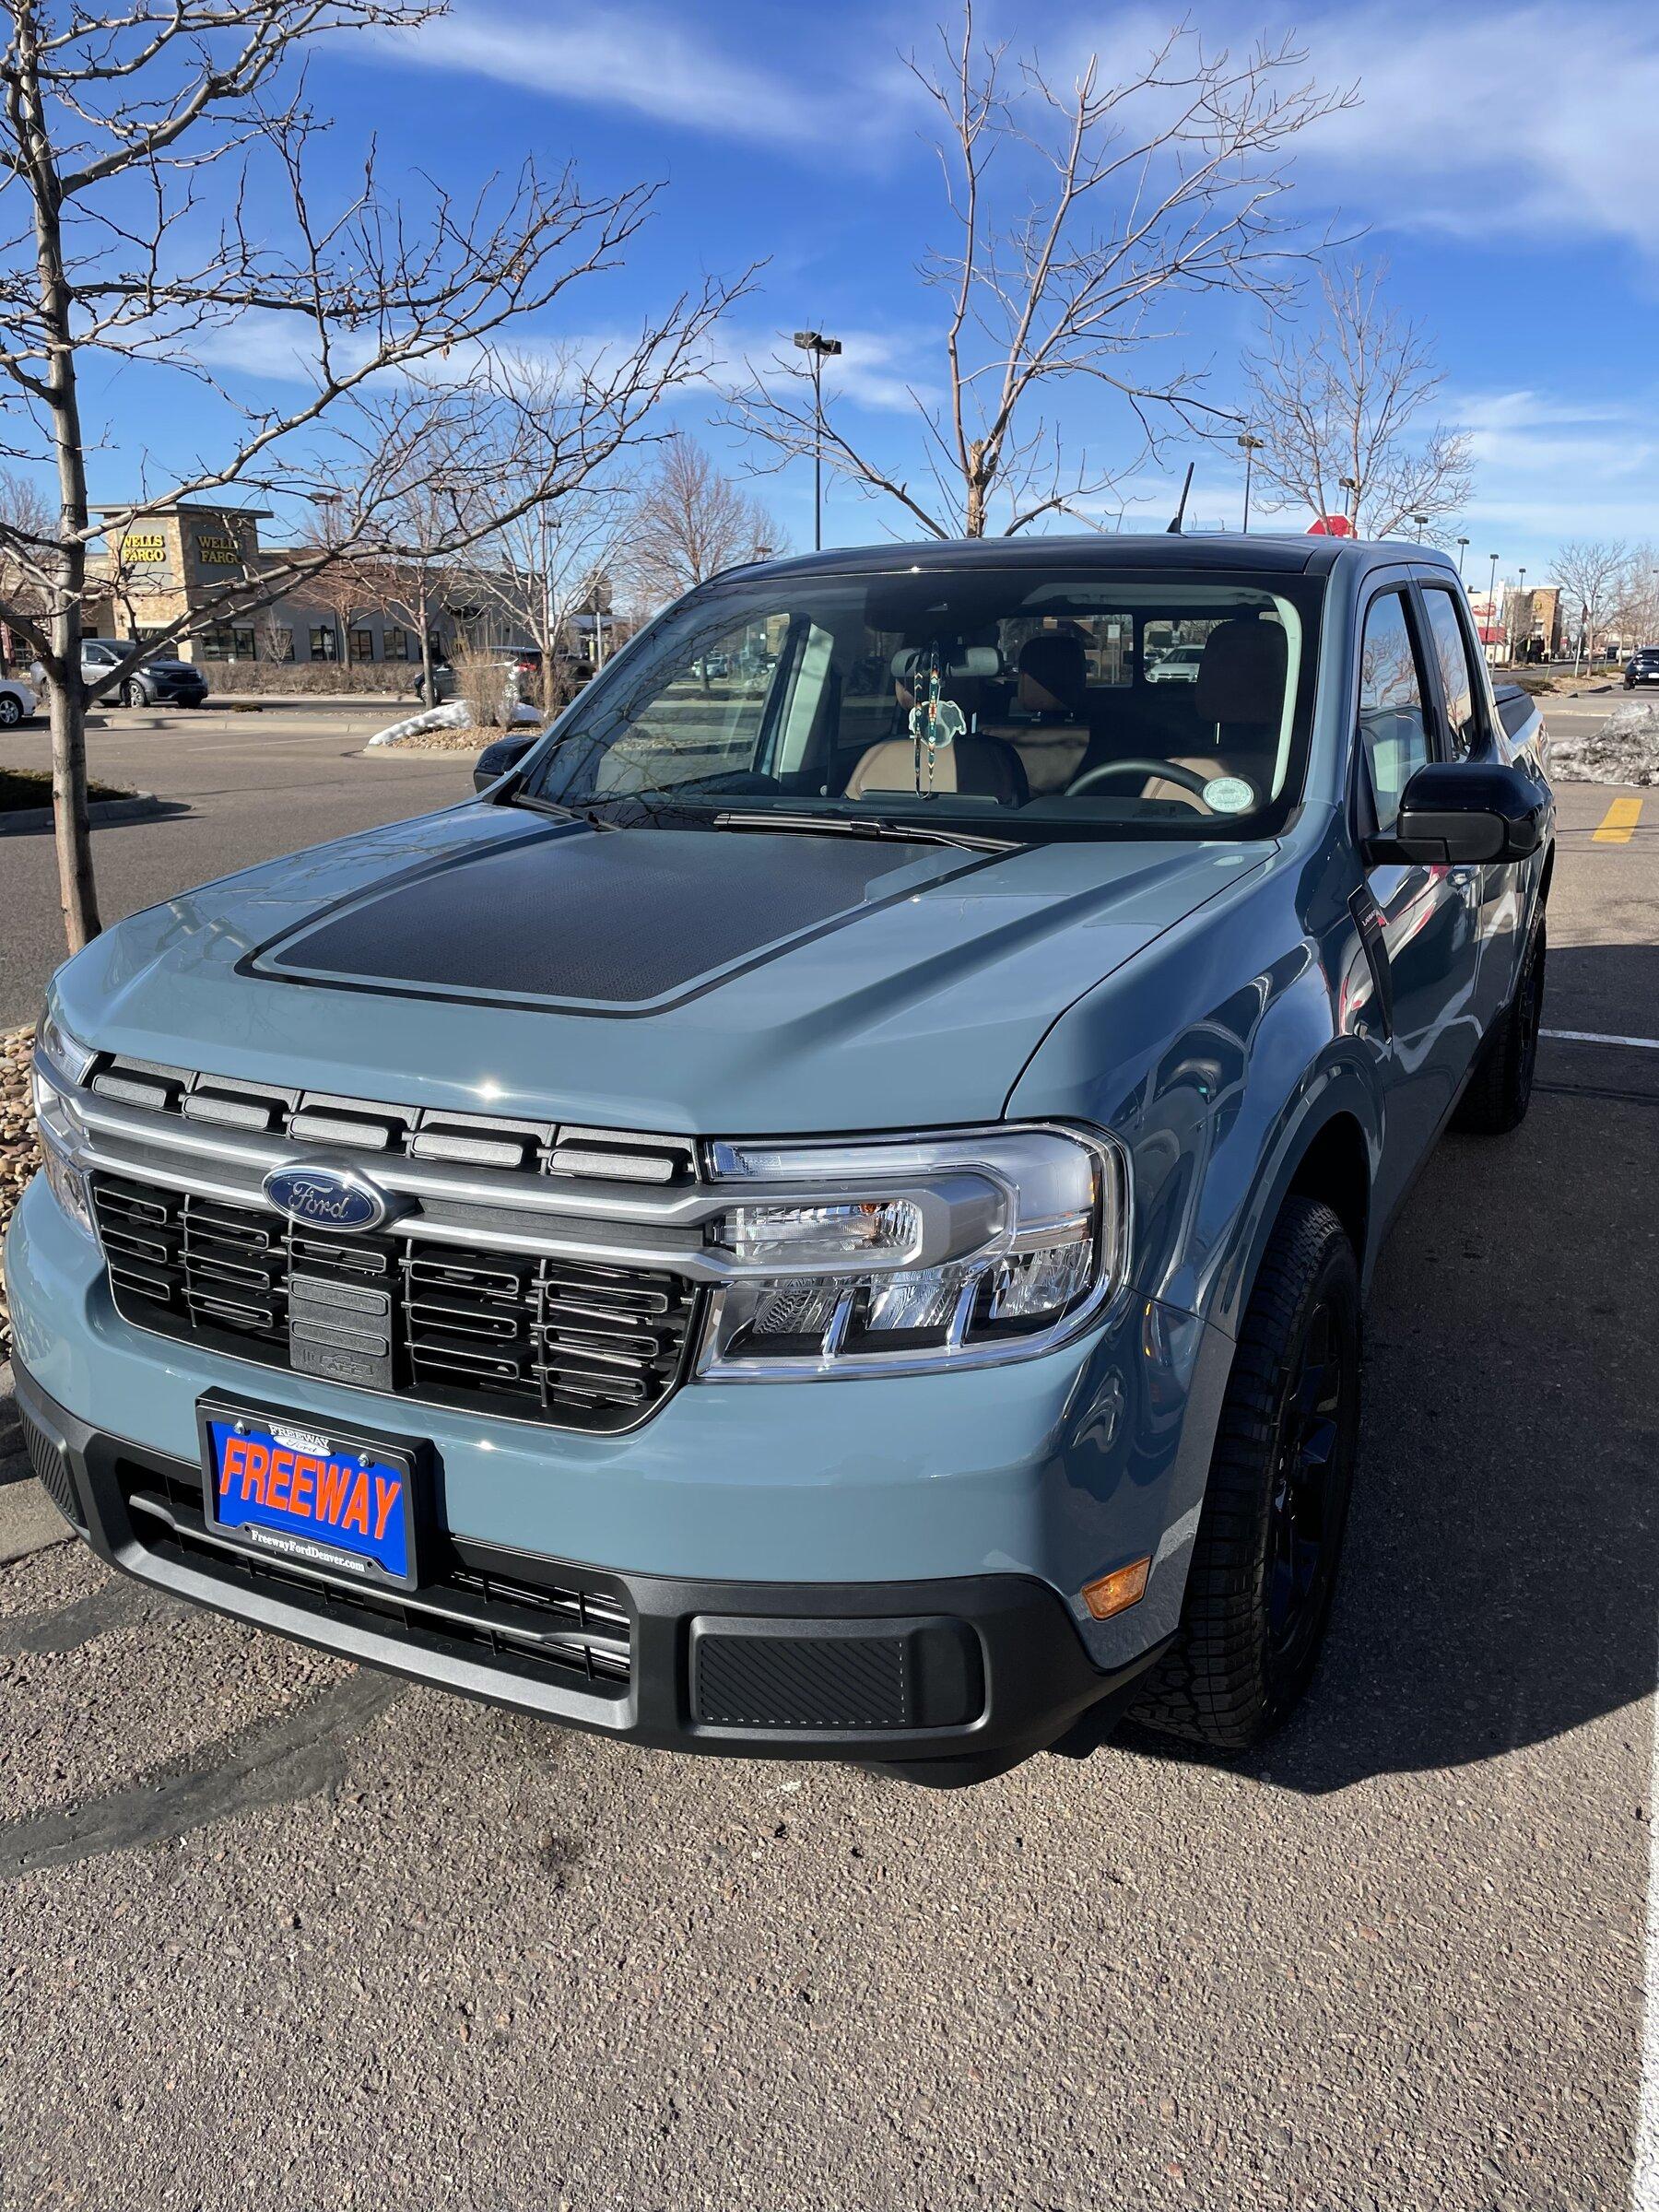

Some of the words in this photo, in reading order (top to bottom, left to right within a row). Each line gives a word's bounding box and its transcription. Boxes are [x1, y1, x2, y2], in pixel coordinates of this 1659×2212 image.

[120, 535, 164, 547] WELLS
[197, 535, 243, 550] WELLS
[123, 548, 165, 562] FARGO
[288, 1181, 352, 1219] Ford
[267, 1424, 330, 1450] FREEWAY
[286, 1439, 318, 1453] Ford
[219, 1437, 402, 1540] FREEWAY
[251, 1529, 366, 1573] FreewayFordDenver.com
